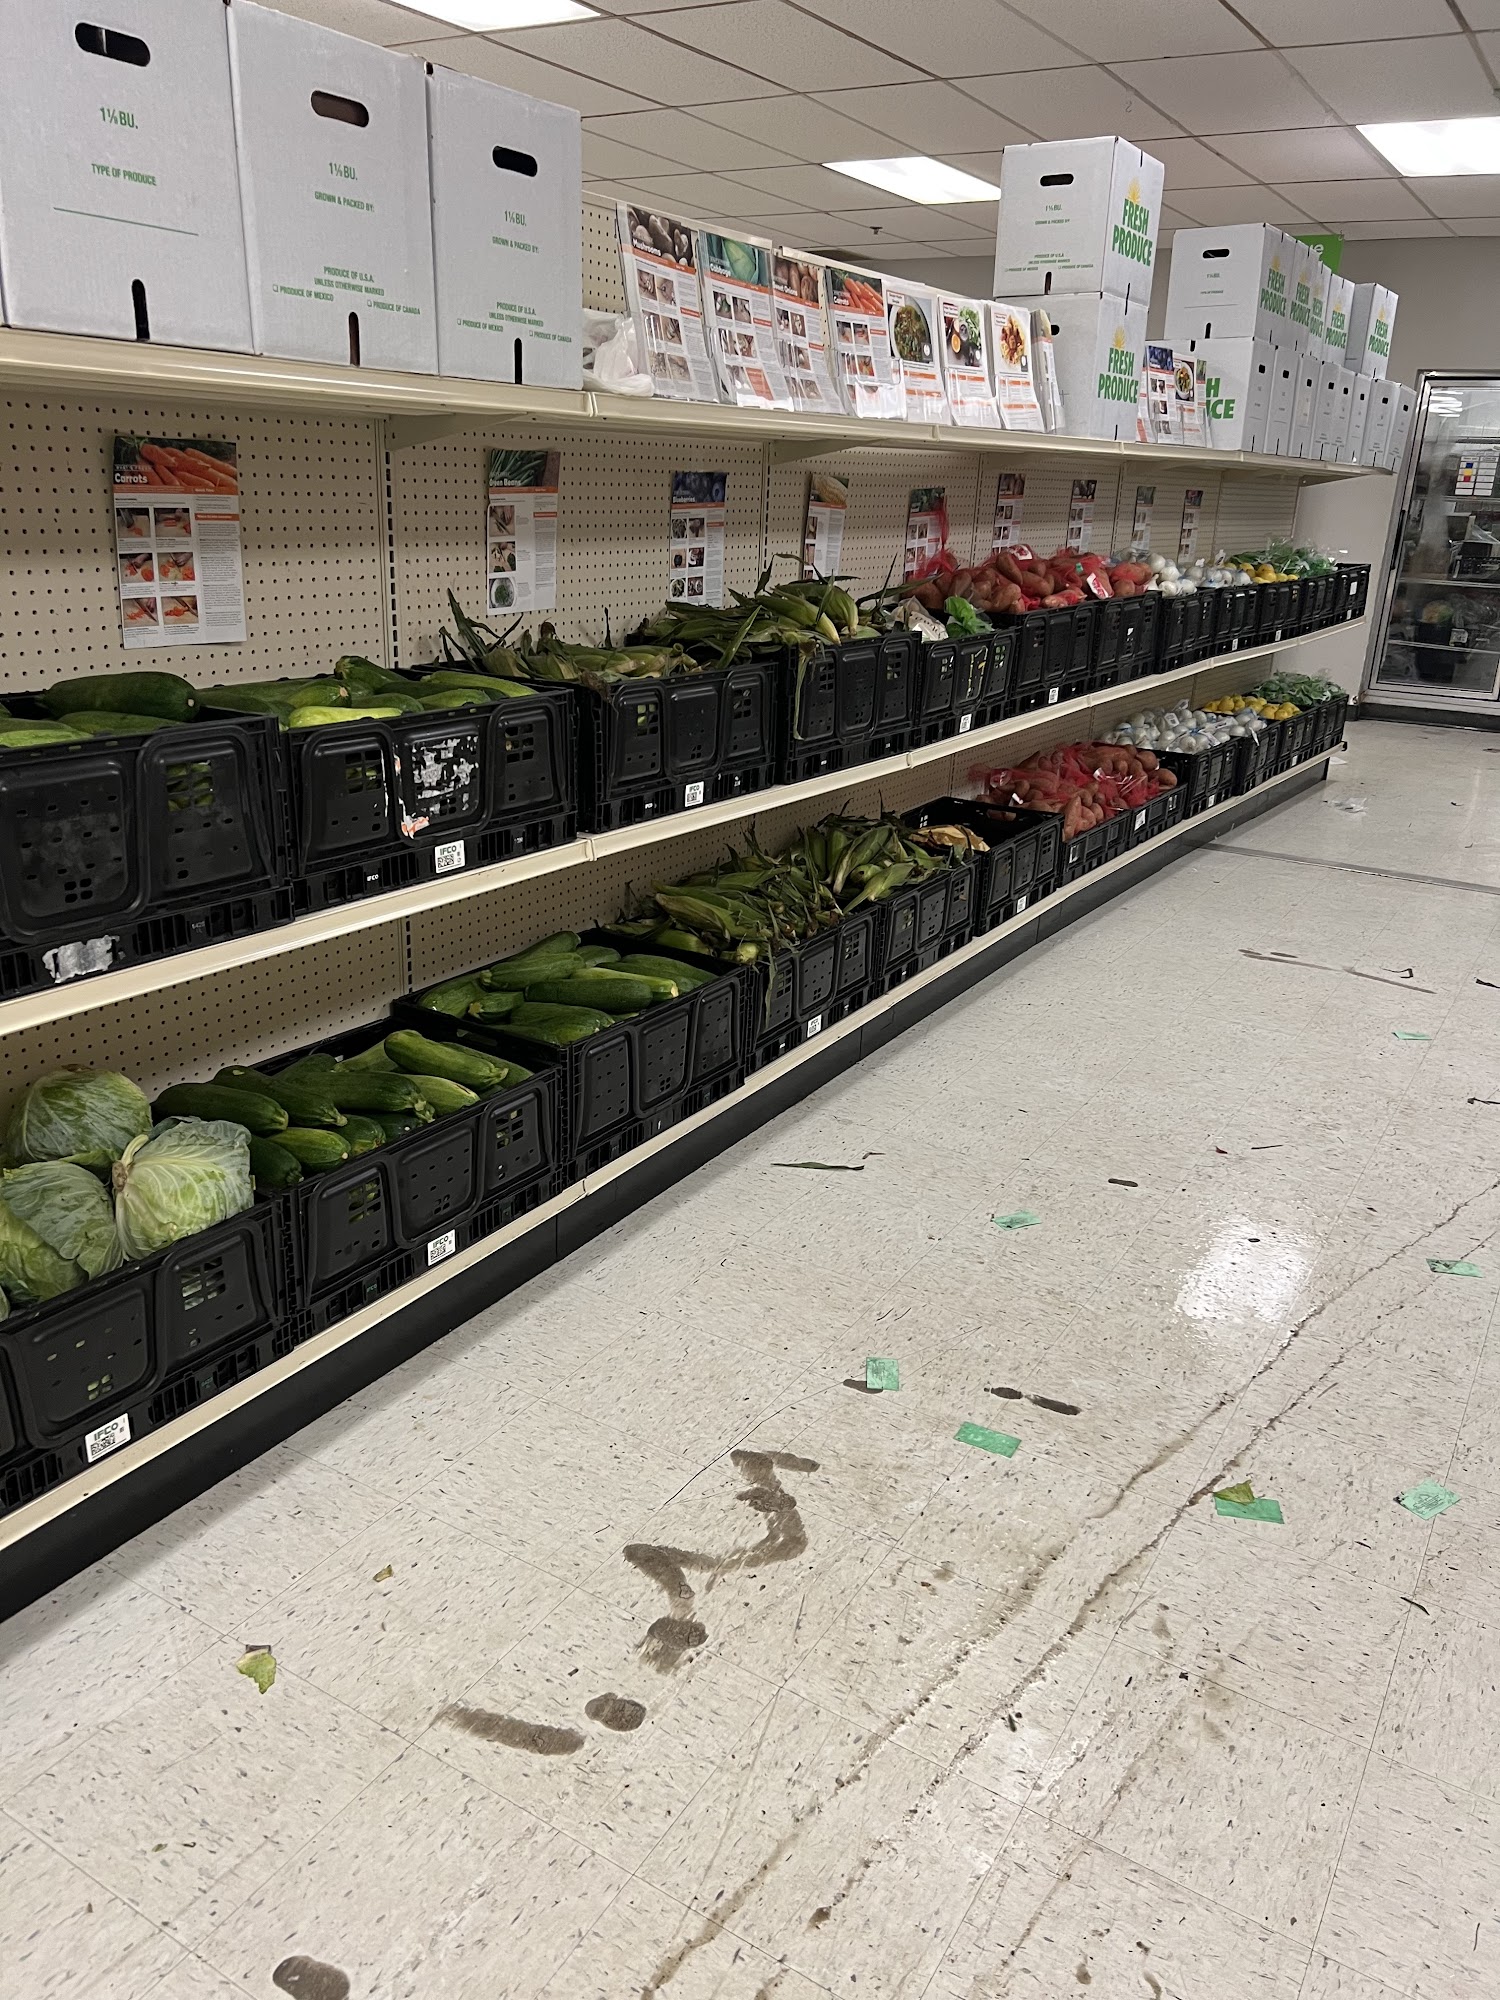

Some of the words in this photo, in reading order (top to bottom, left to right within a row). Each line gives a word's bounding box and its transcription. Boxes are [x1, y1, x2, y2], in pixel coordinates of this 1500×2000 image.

[91, 163, 110, 177] TYPE
[112, 167, 121, 178] OF
[123, 170, 157, 186] PRODUCE
[315, 191, 336, 204] GROWN
[338, 197, 342, 205] &
[343, 197, 365, 210] PACKED
[1122, 198, 1149, 236] FRESH
[492, 236, 509, 247] GROWN
[514, 241, 531, 252] PACKED
[1112, 224, 1153, 267] PRODUCE
[323, 266, 350, 279] PRODUCE
[351, 271, 358, 280] OF
[1267, 268, 1286, 295] FRESH
[280, 285, 305, 297] PRODUCE
[306, 290, 312, 298] OF
[314, 291, 334, 301] MEXICO
[314, 277, 334, 288] UNLESS
[335, 281, 363, 292] OTHERWISE
[364, 285, 385, 296] MARKED
[1296, 282, 1310, 306] FRESH
[373, 301, 395, 312] PRODUCE
[396, 304, 402, 312] OF
[402, 306, 421, 315] CANADA
[497, 302, 517, 312] PRODUCE
[1260, 287, 1287, 317] PRODUCE
[1289, 301, 1311, 327] PRODUCE
[1331, 310, 1345, 331] FRESH
[463, 320, 481, 329] PRODUCE
[482, 322, 487, 330] OF
[488, 323, 503, 332] MEXICO
[1374, 318, 1388, 339] FRESH
[534, 331, 551, 340] PRODUCE
[557, 335, 572, 343] CANADA
[1324, 327, 1347, 349] PRODUCE
[1368, 334, 1389, 357] PRODUCE
[1108, 347, 1135, 377] FRESH
[1098, 373, 1139, 404] PRODUCE
[115, 472, 148, 483] Carrots
[504, 478, 521, 487] Beans
[440, 845, 457, 856] IFCO
[366, 874, 379, 882] IFCO
[432, 1235, 449, 1249] IFCO
[93, 1422, 119, 1441] IFCO
